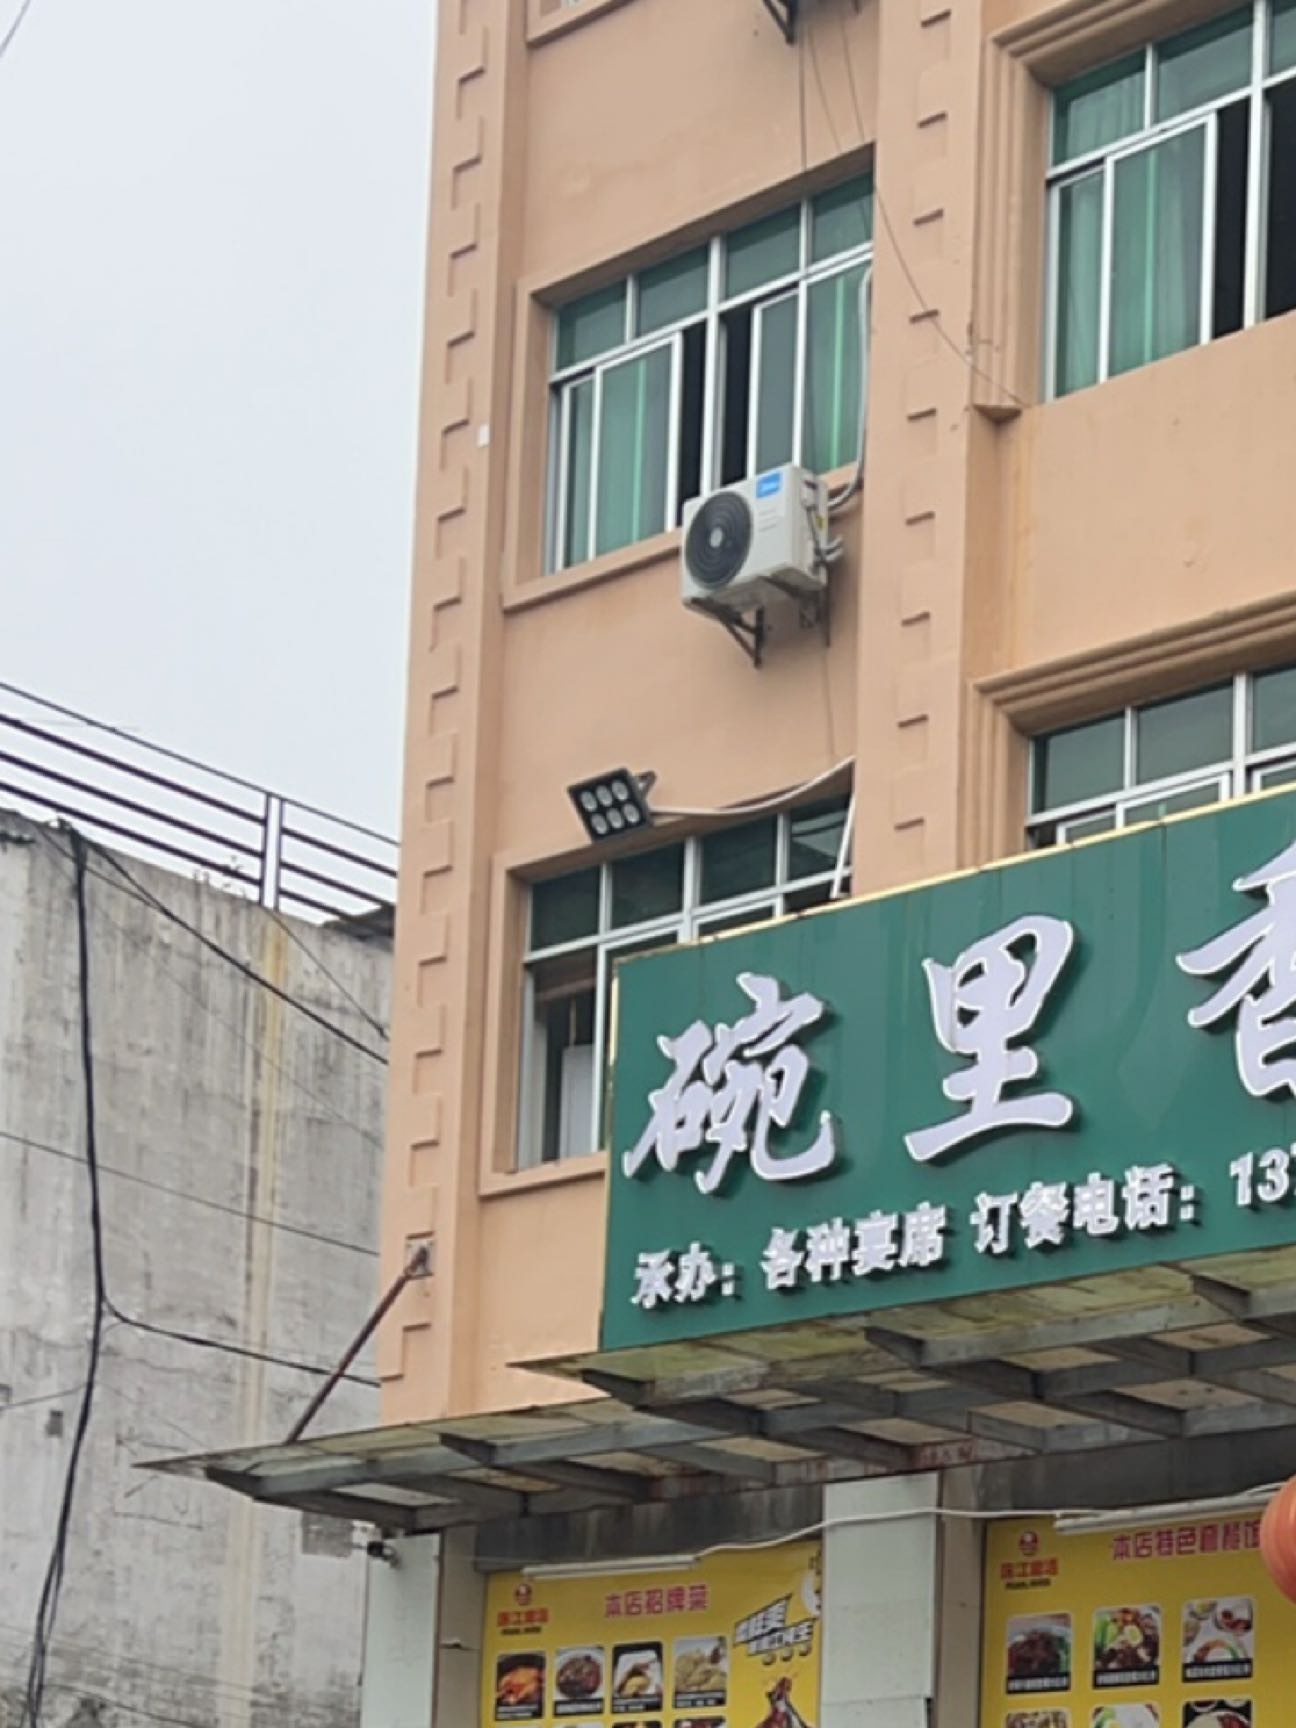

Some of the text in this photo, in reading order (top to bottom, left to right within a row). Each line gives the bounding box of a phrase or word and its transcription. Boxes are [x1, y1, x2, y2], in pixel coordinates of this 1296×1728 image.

[761, 1200, 946, 1290] 各种宴席
[604, 1583, 709, 1618] 本店招牌菜
